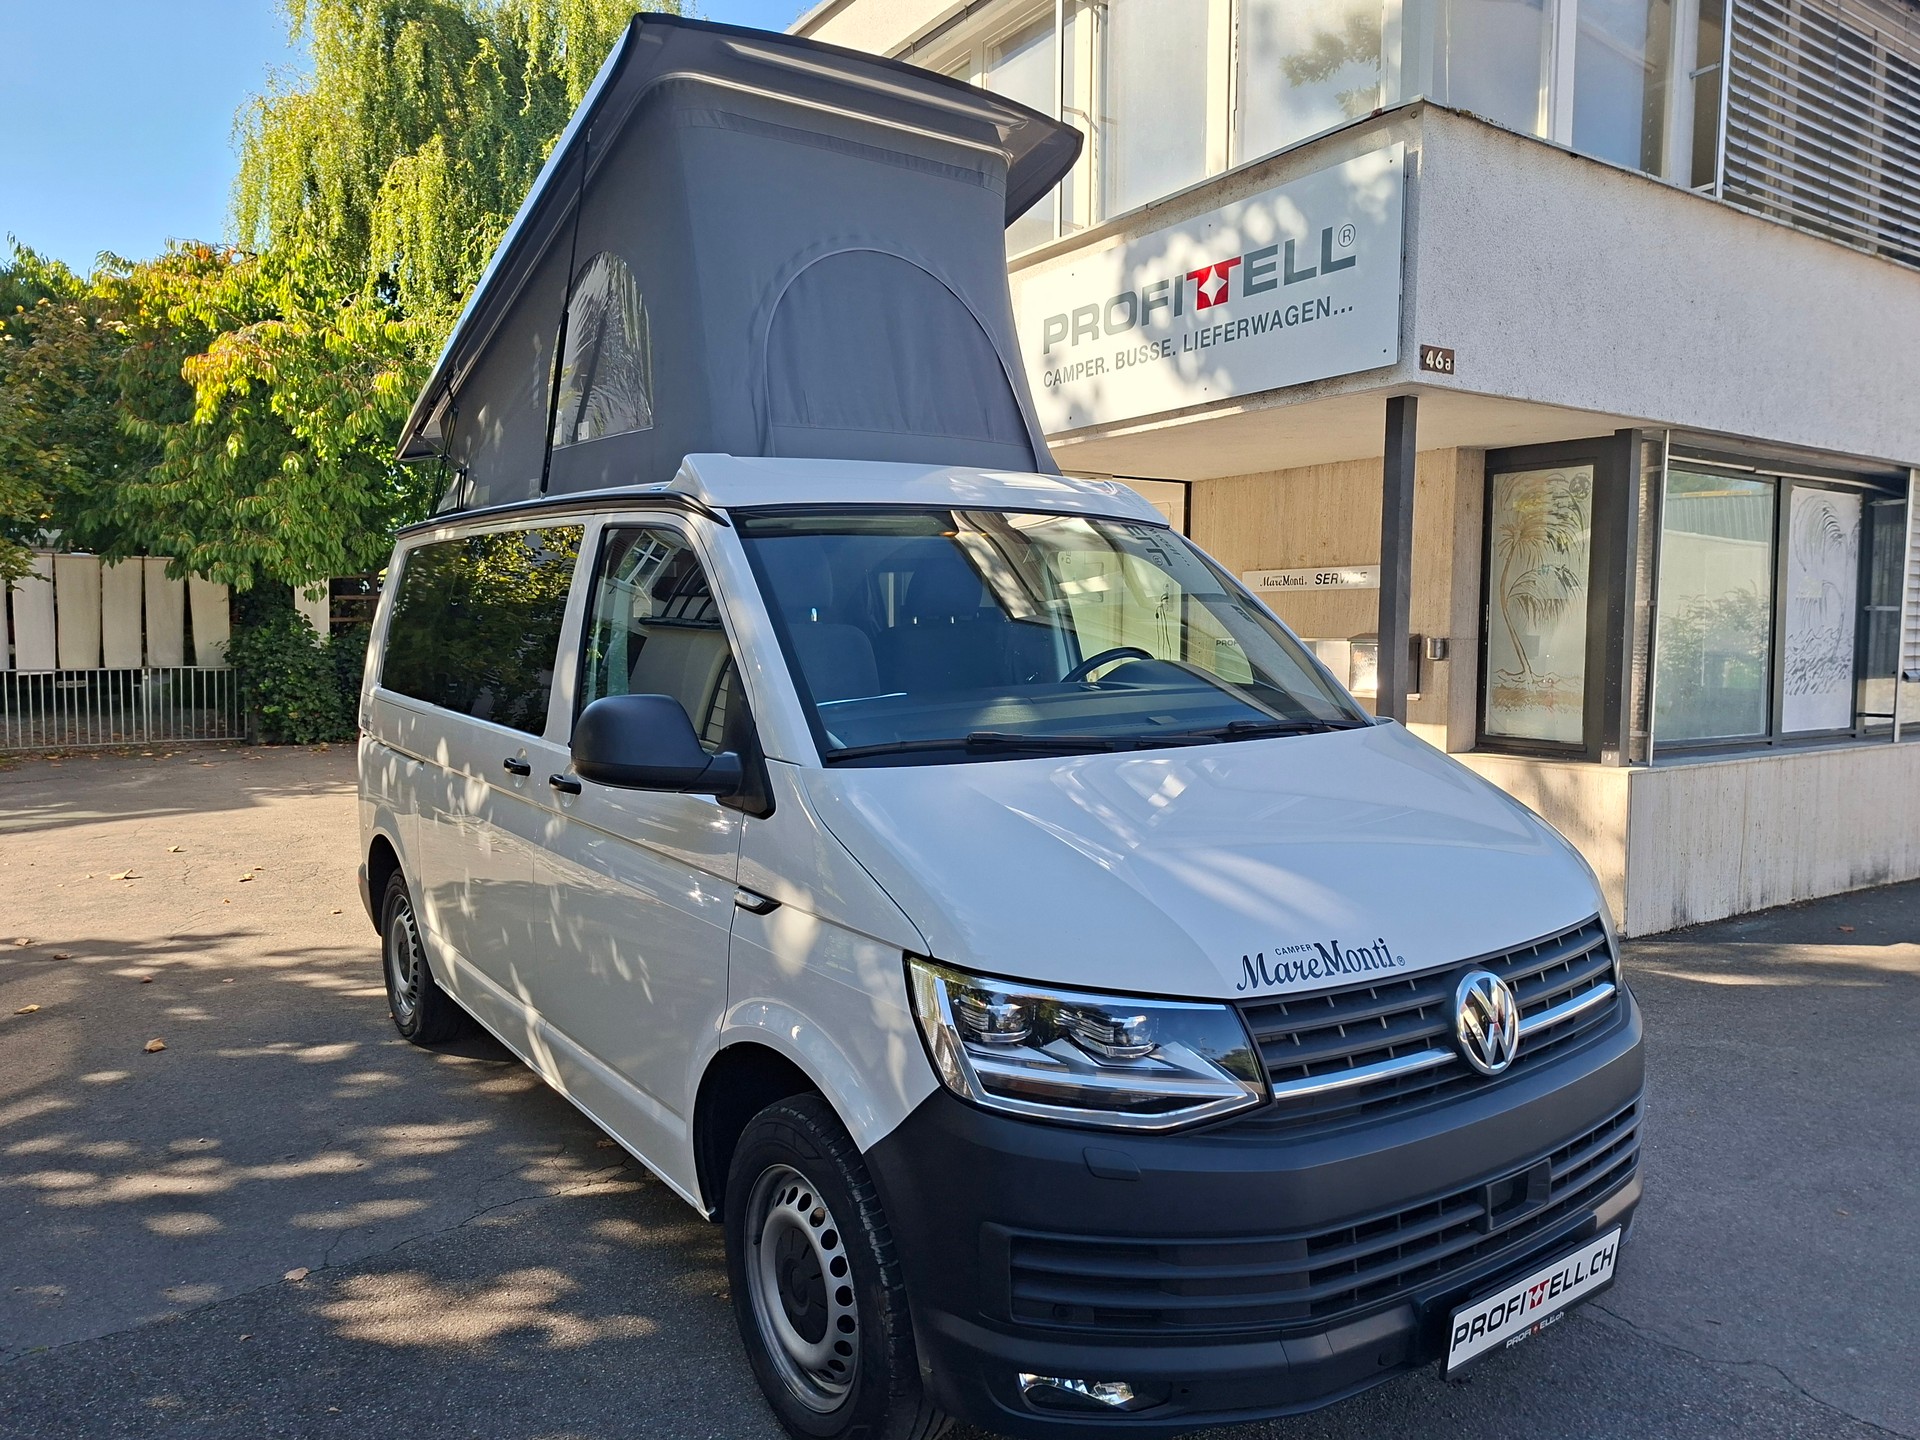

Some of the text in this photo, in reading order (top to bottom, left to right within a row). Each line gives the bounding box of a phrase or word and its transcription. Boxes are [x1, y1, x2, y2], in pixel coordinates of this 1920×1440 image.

[1043, 295, 1354, 388] CAMPER. BUSSE. LIEFERWAGEN...
[1425, 350, 1451, 371] 46a
[1315, 571, 1367, 585] SERVE
[1274, 943, 1313, 956] CAMPER
